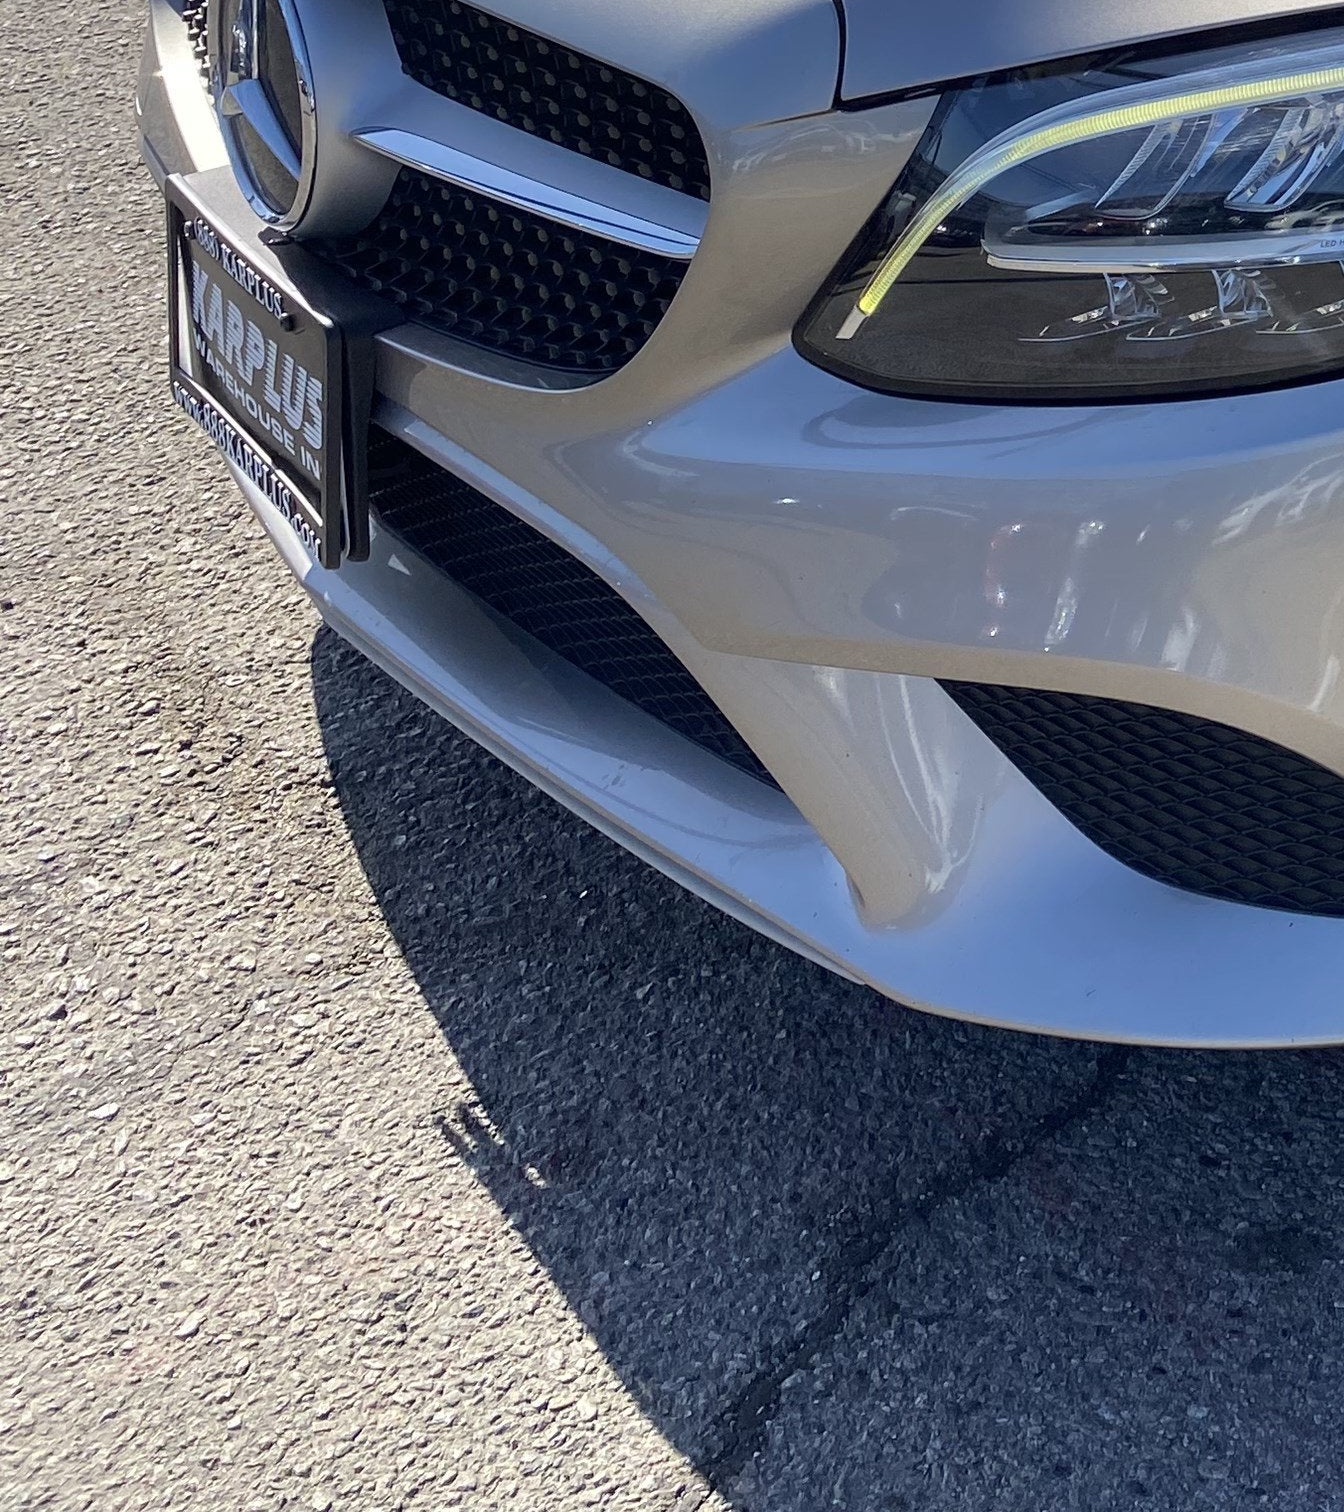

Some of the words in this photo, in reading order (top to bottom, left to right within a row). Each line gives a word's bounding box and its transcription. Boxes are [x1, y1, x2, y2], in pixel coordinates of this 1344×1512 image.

[194, 216, 220, 261] (888)
[221, 243, 282, 319] KARPLUS
[1320, 240, 1337, 248] LED
[192, 259, 322, 451] KARPLUS
[193, 328, 296, 456] WAREHOUSE
